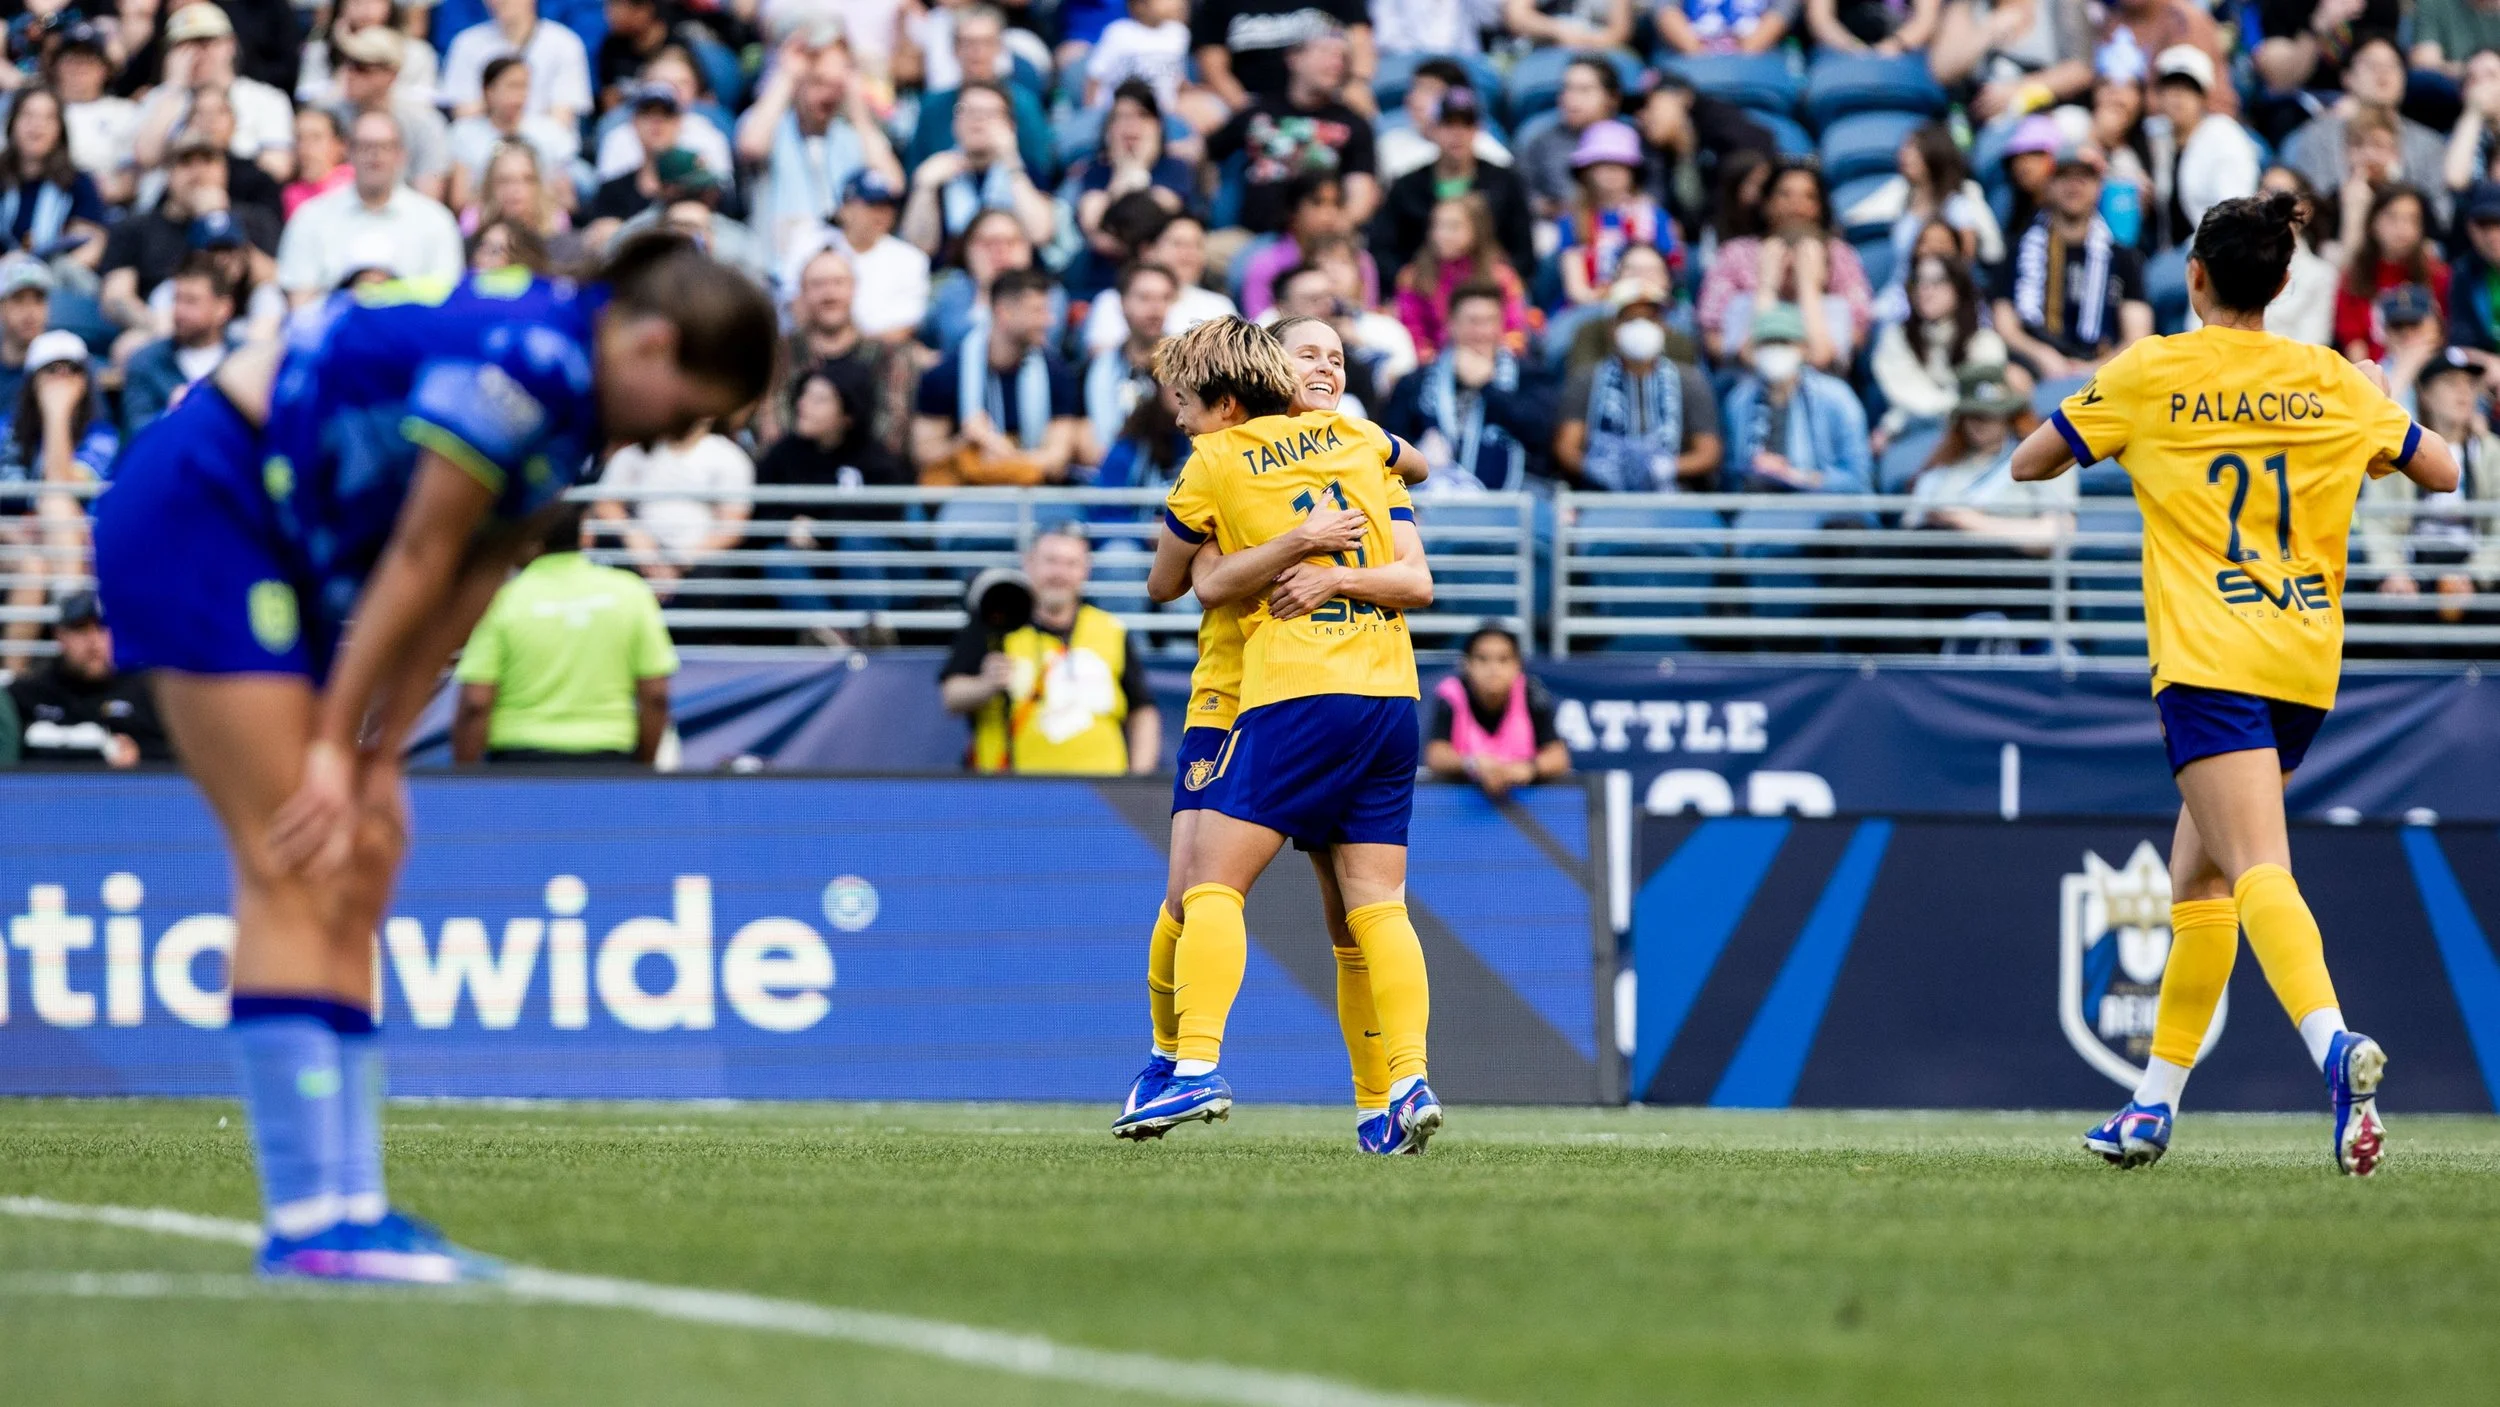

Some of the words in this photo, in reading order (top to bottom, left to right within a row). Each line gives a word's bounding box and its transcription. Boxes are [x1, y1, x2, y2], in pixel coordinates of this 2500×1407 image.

[2170, 391, 2325, 423] PALACIOS
[1243, 424, 1343, 476] TANAKA
[2206, 449, 2292, 564] 21
[2216, 568, 2332, 611] SME
